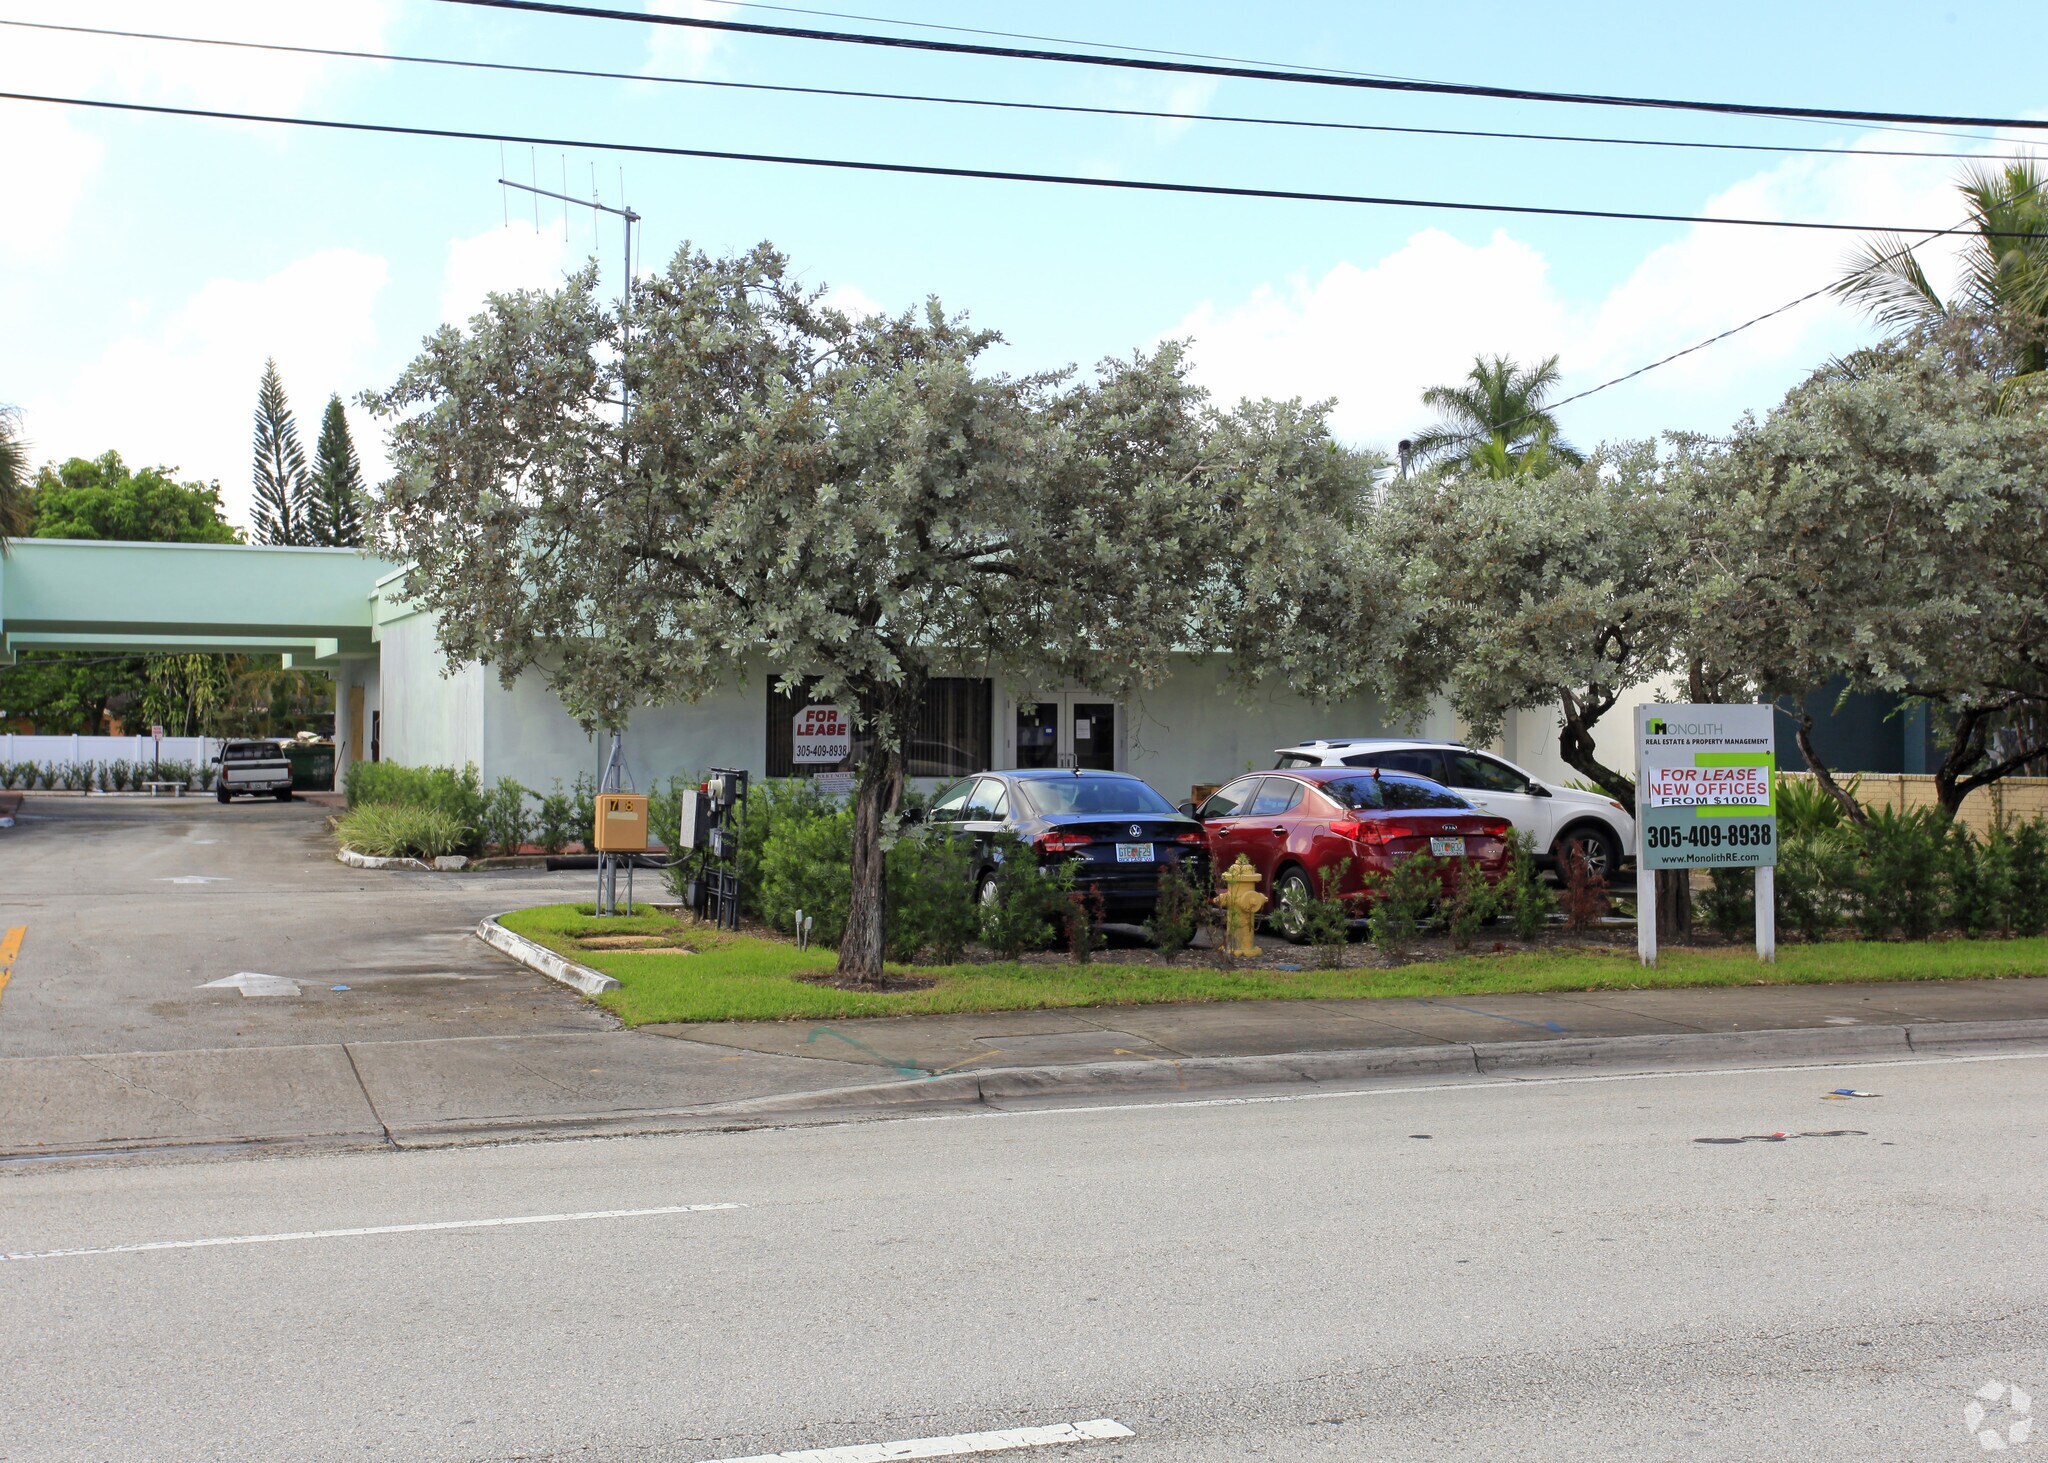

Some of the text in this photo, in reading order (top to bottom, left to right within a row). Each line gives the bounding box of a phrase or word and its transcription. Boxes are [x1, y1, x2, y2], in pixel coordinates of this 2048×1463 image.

[806, 710, 838, 722] FOR
[797, 724, 847, 736] LEASE
[1654, 723, 1723, 735] MONOLITH
[797, 745, 847, 757] 305-409-8938
[1660, 769, 1757, 781] FOR LEASE
[1651, 782, 1767, 796] NEW OFFICES
[1661, 796, 1757, 805] FROM $1000
[1647, 824, 1772, 848] 305-409-8938
[1661, 853, 1760, 863] www.MonolithRE.com
